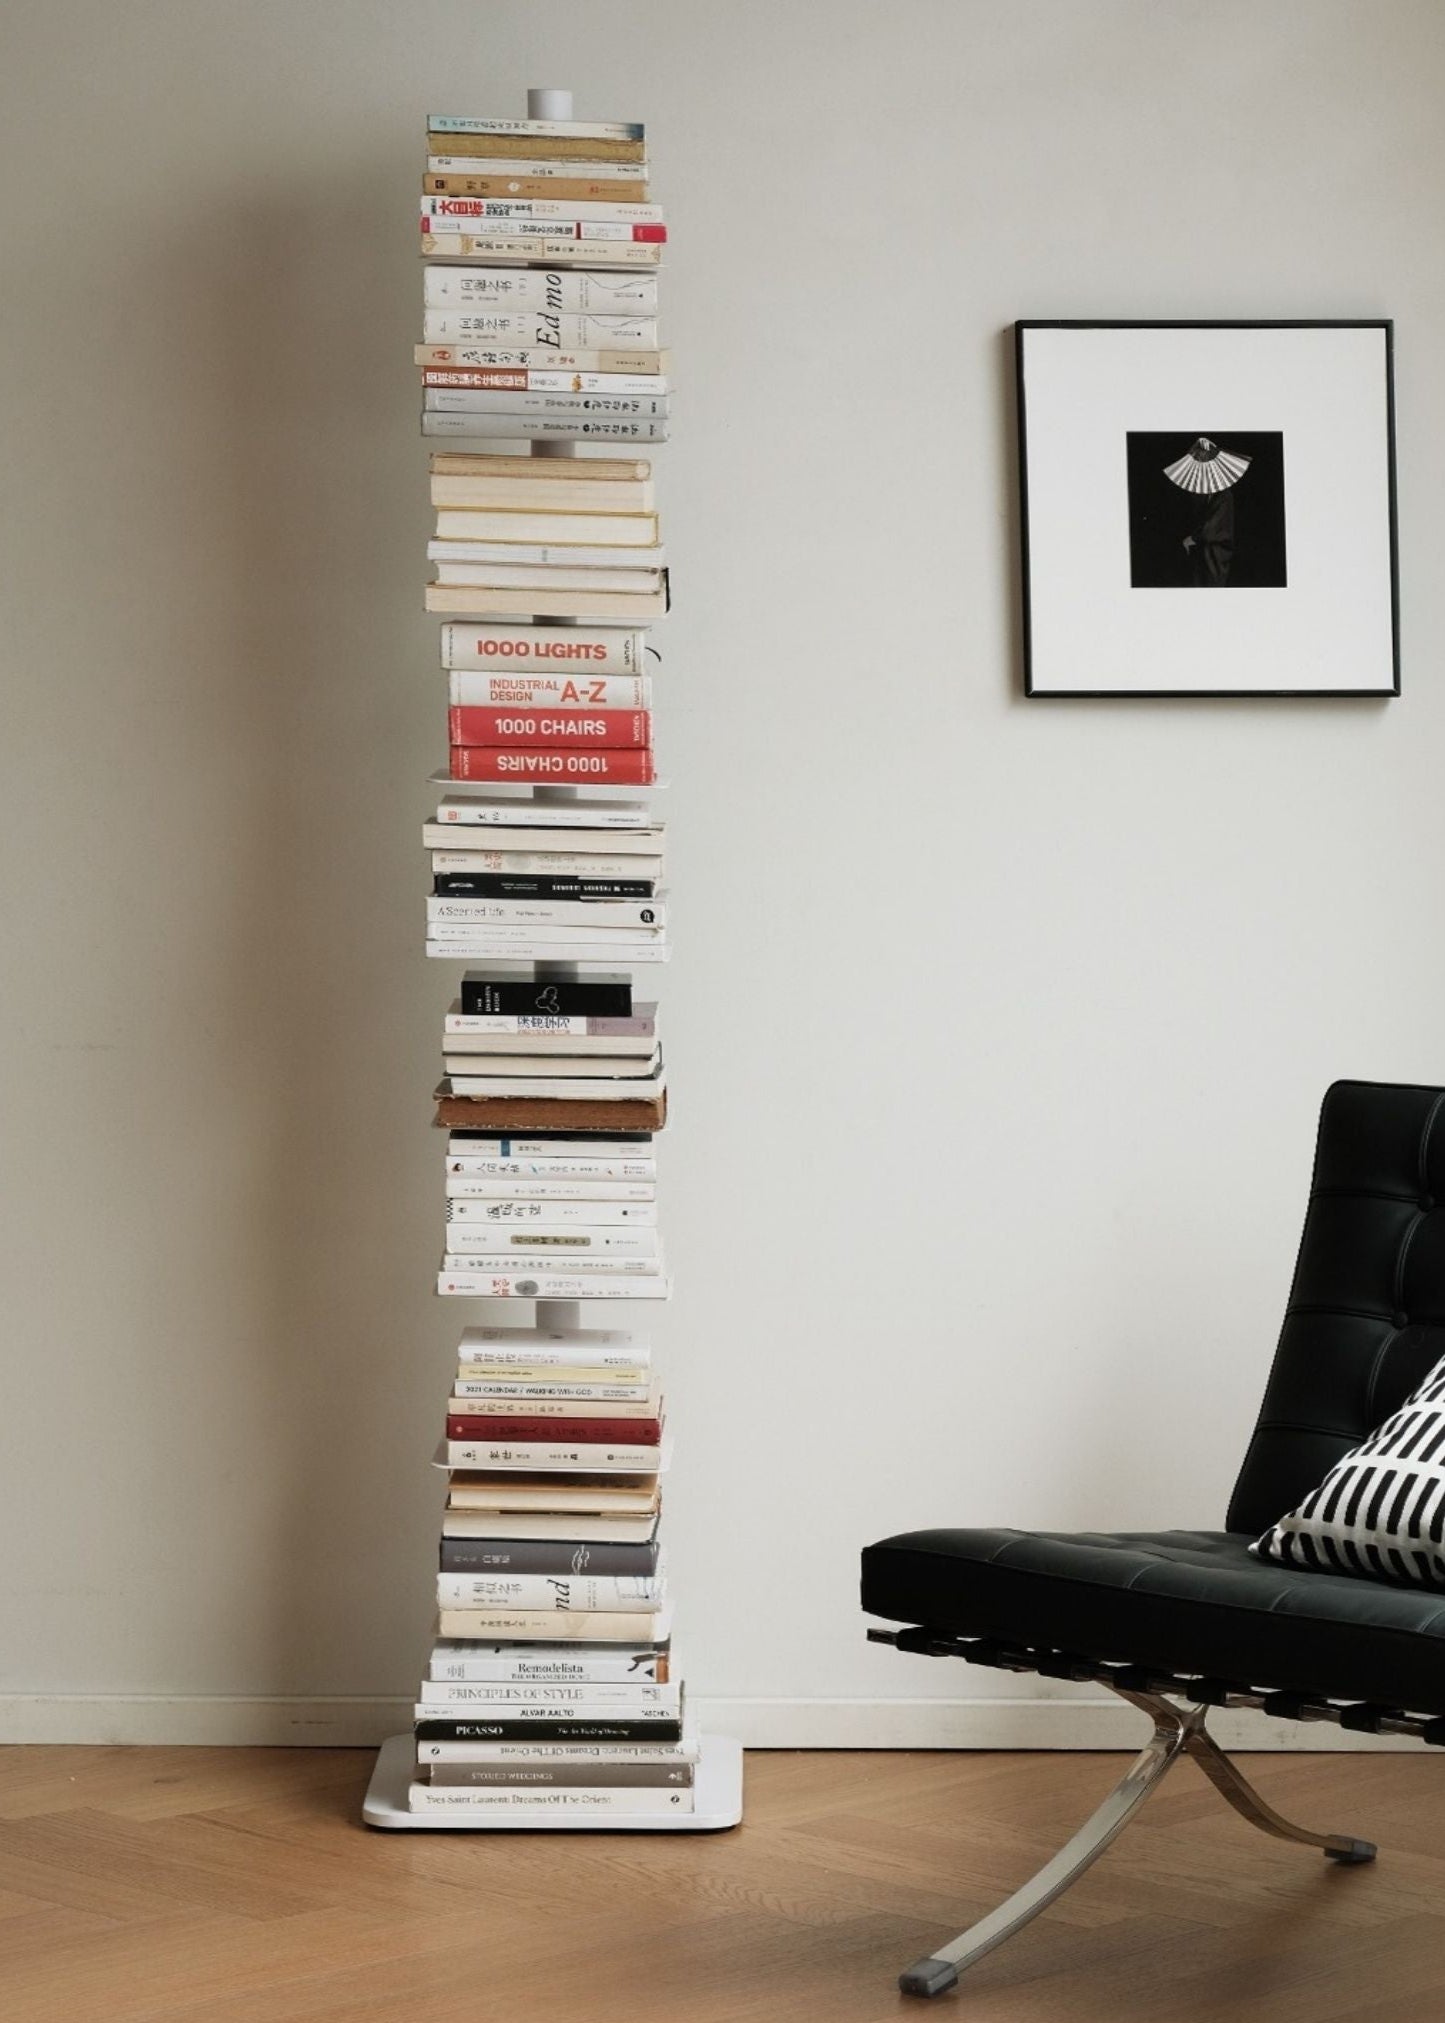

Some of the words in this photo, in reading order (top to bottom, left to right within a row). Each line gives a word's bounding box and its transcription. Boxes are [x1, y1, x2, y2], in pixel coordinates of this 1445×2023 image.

[439, 199, 484, 216] 大目标
[477, 640, 530, 657] 1000
[534, 642, 607, 660] LIGHTS
[490, 679, 560, 691] INDUSTRIAL
[560, 681, 607, 703] A-Z
[490, 691, 533, 702] DESIGN
[495, 718, 536, 734] 1000
[540, 719, 606, 736] CHAIRS
[497, 755, 564, 771] CHAIRS
[567, 756, 608, 773] 1000
[518, 1663, 584, 1673] Remodelista
[448, 1688, 521, 1699] PRINCIPLES
[523, 1688, 540, 1699] OF
[543, 1689, 584, 1700] STYLE
[520, 1709, 544, 1717] ALVAR
[547, 1709, 574, 1717] AALTO
[456, 1725, 504, 1736] PICASSO
